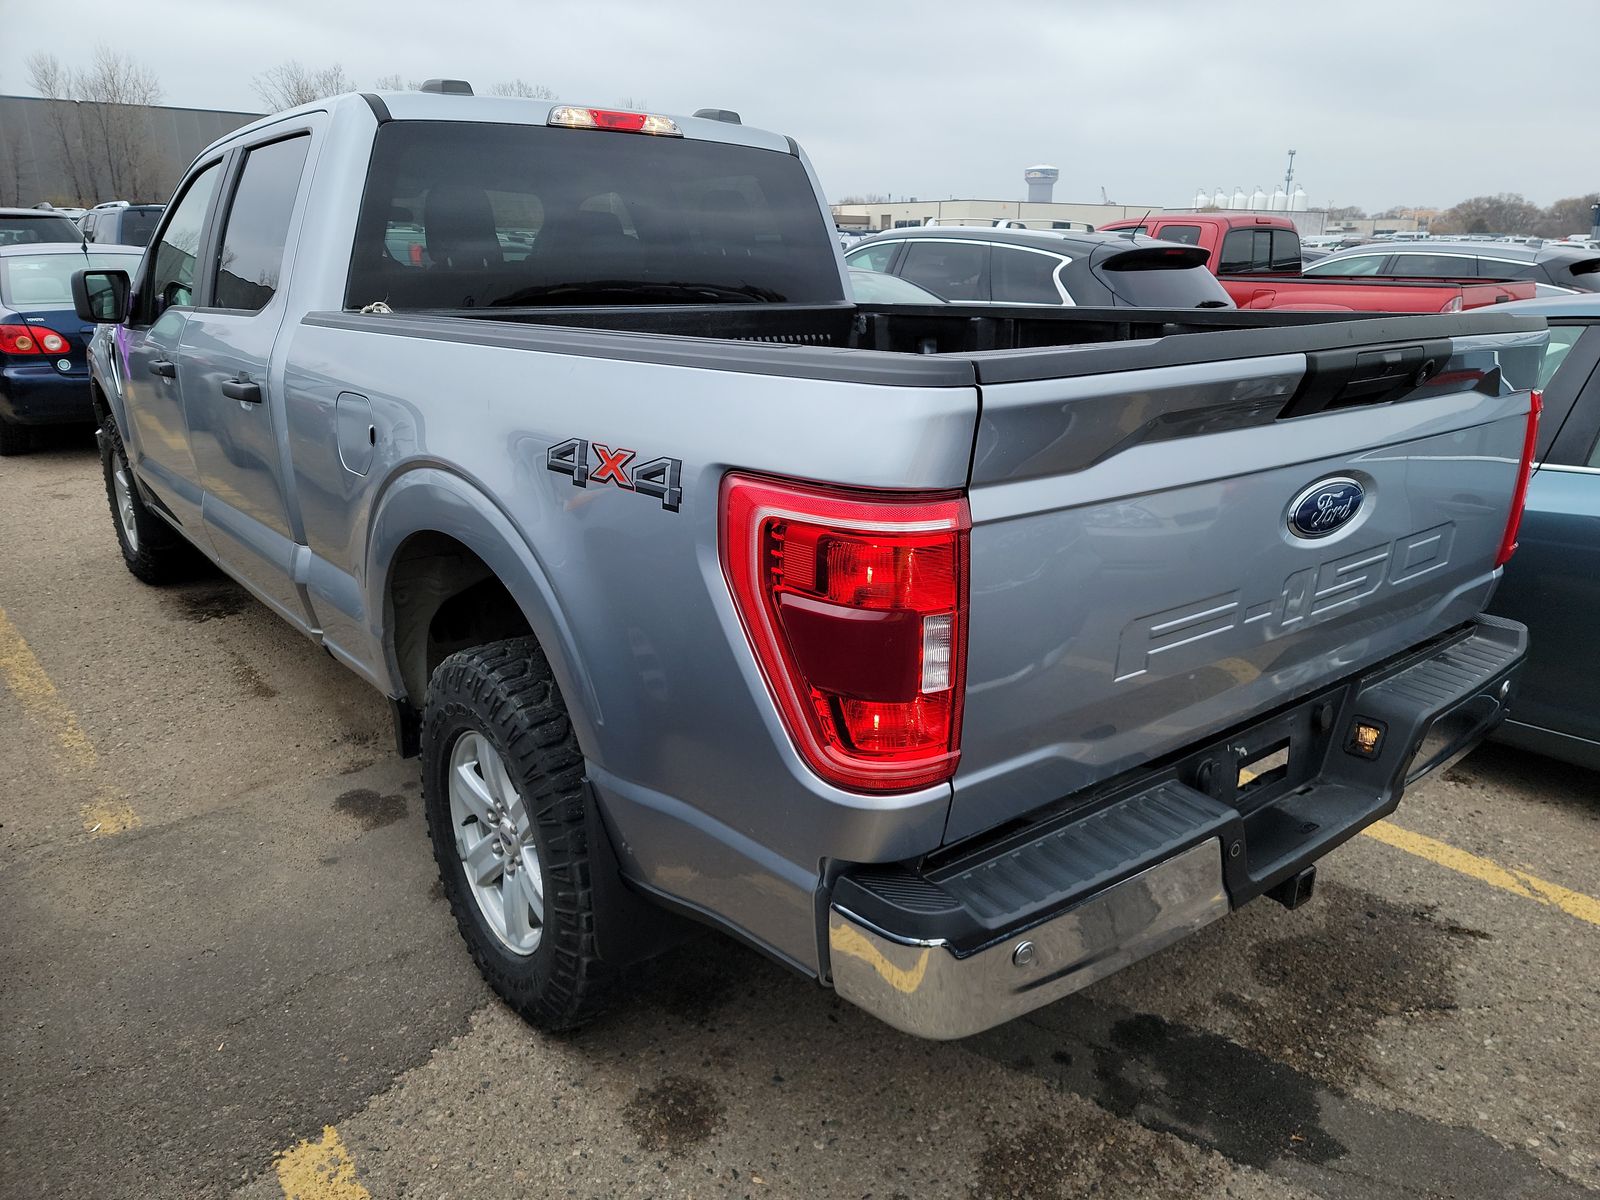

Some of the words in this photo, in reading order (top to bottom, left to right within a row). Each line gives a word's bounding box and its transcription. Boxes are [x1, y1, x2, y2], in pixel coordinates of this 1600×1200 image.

[1311, 491, 1354, 527] Ford
[1113, 520, 1456, 682] F-150
[430, 701, 504, 749] GOODY
